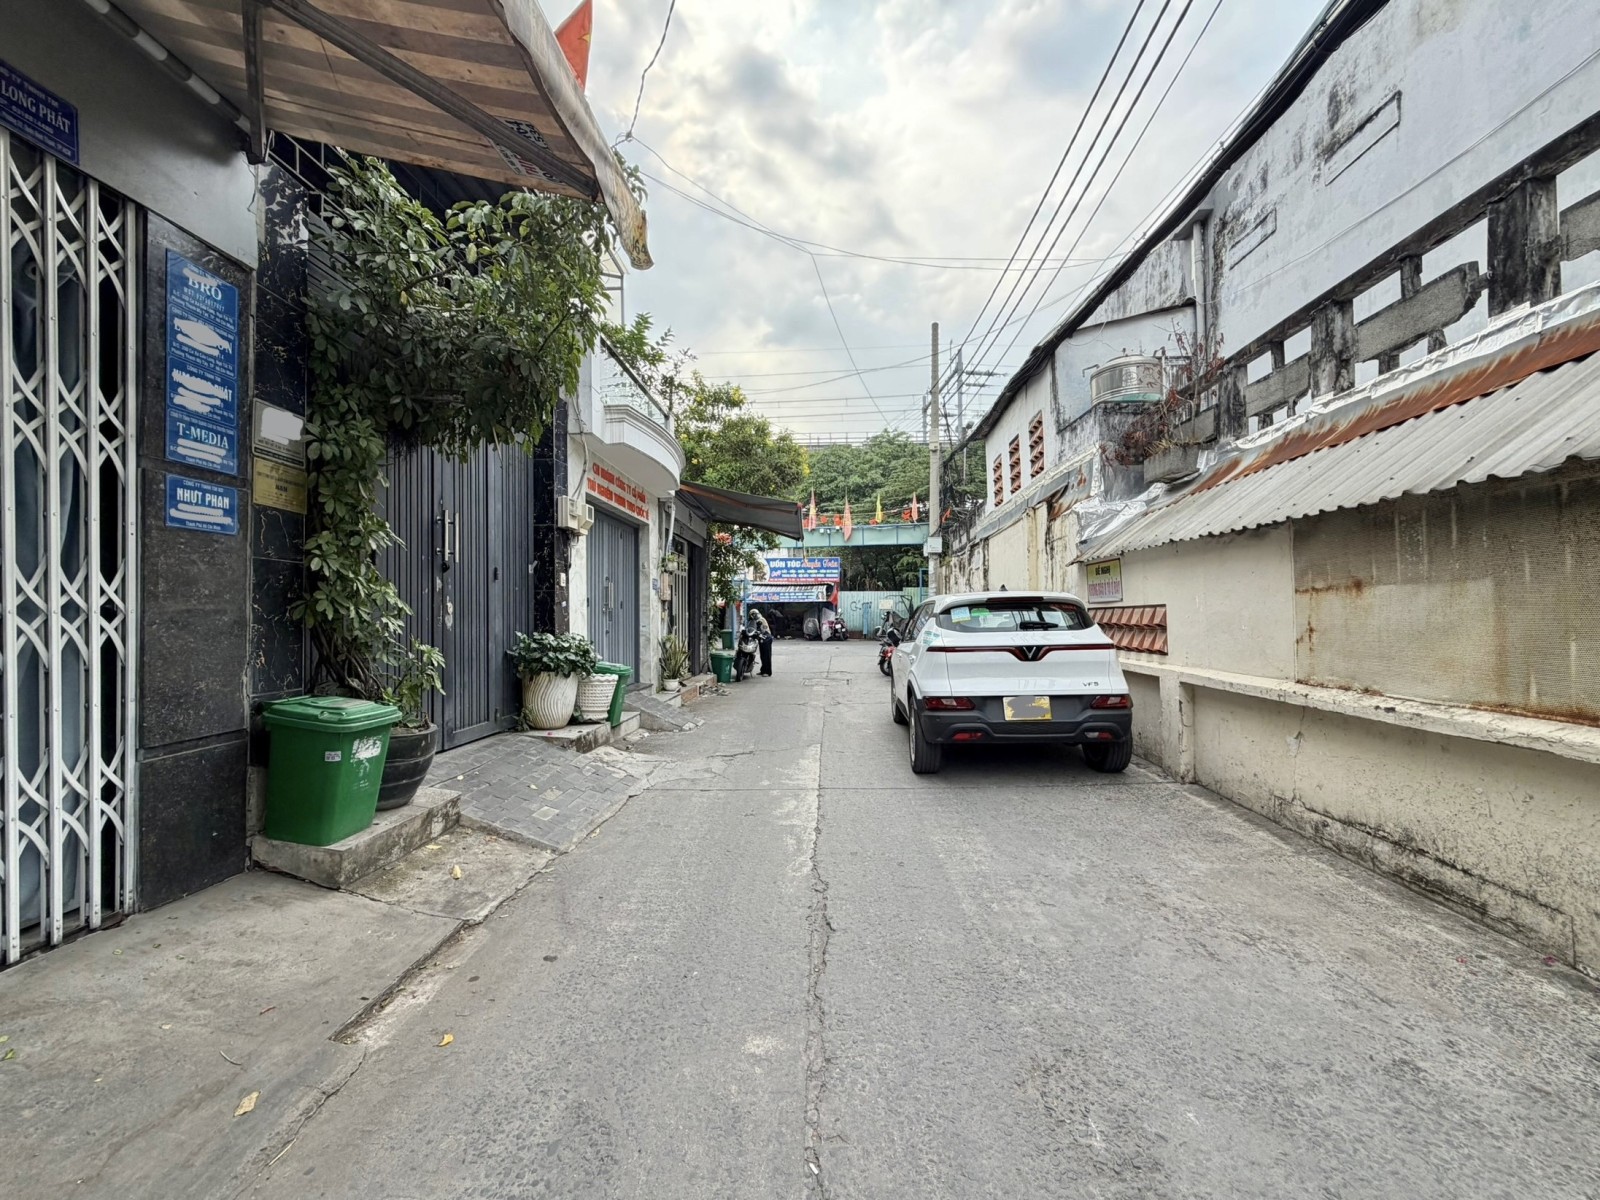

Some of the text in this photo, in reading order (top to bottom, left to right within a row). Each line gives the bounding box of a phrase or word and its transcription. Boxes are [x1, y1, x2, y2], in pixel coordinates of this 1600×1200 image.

[1, 79, 37, 113] LONG
[39, 102, 71, 134] PHÁT
[188, 277, 222, 300] BRO
[176, 421, 228, 448] T-MEDIA
[205, 492, 229, 509] PHAN
[769, 559, 785, 568] UỐN
[787, 559, 801, 568] TÓC
